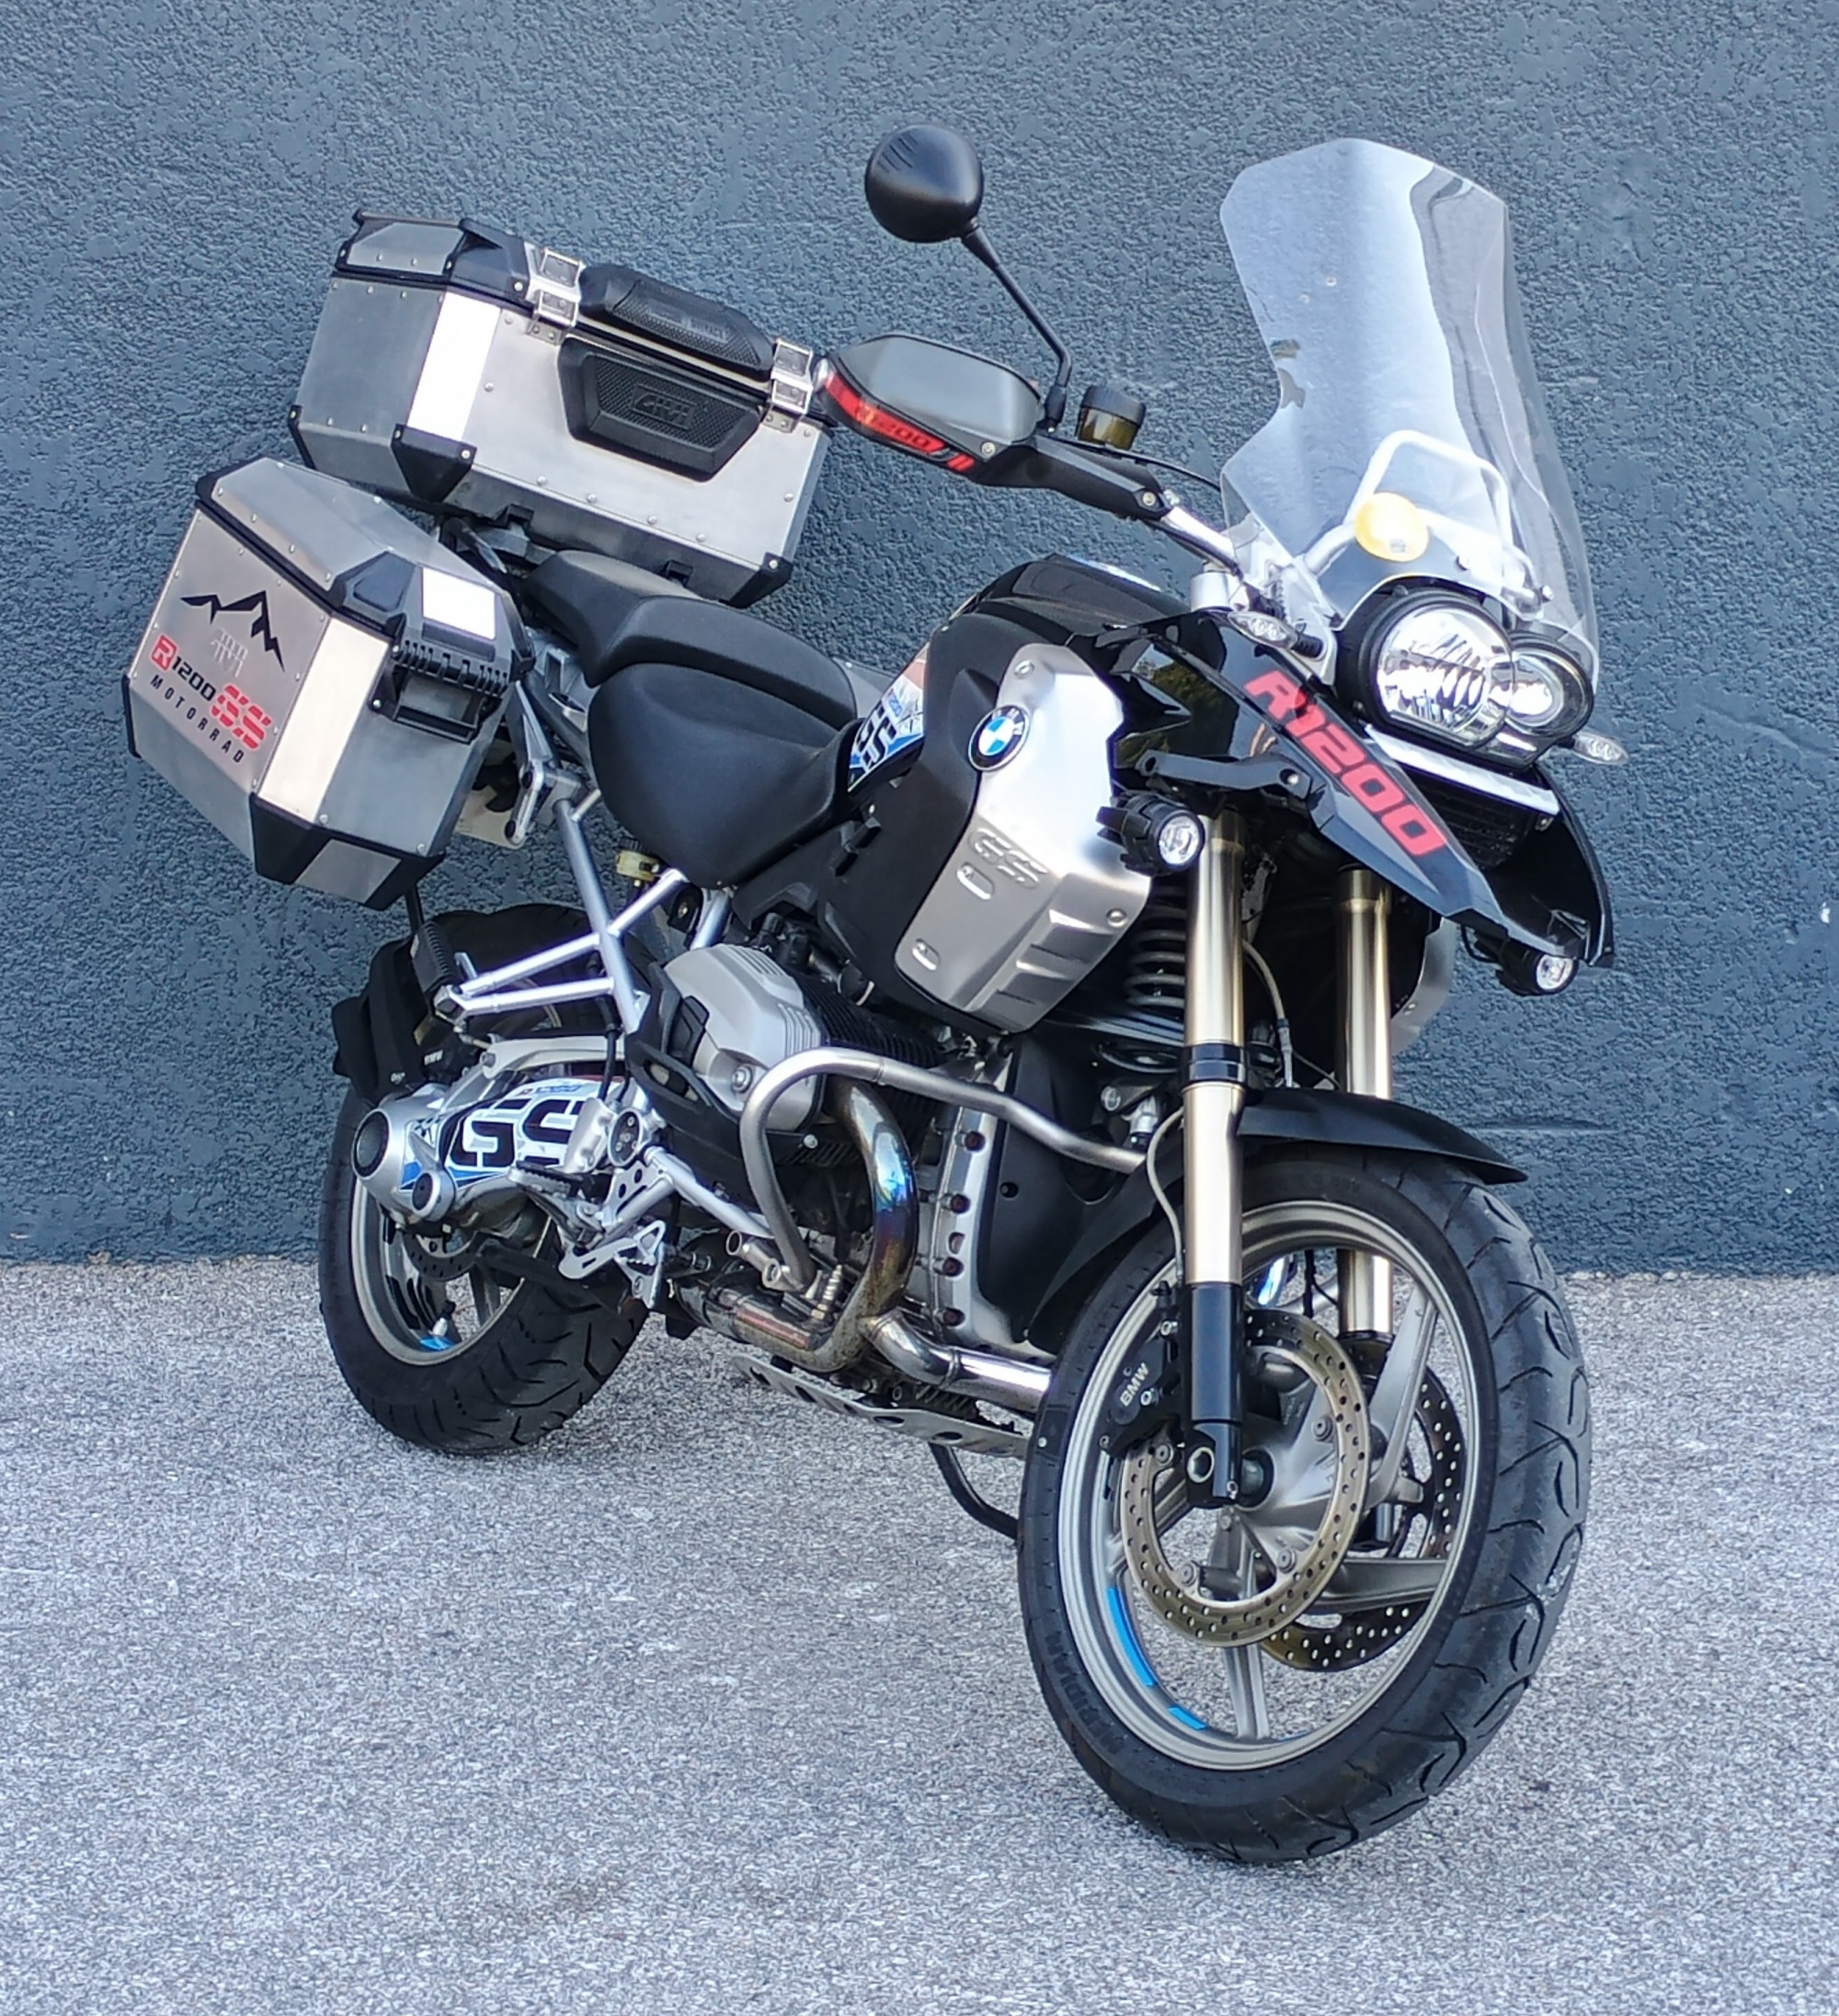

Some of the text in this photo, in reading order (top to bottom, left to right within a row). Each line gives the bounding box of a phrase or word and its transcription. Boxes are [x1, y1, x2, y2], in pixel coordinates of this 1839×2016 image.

[151, 675, 245, 763] MOTORRAD
[1244, 669, 1447, 857] R1200
[968, 828, 1048, 890] GS
[1120, 1362, 1148, 1407] BMW
